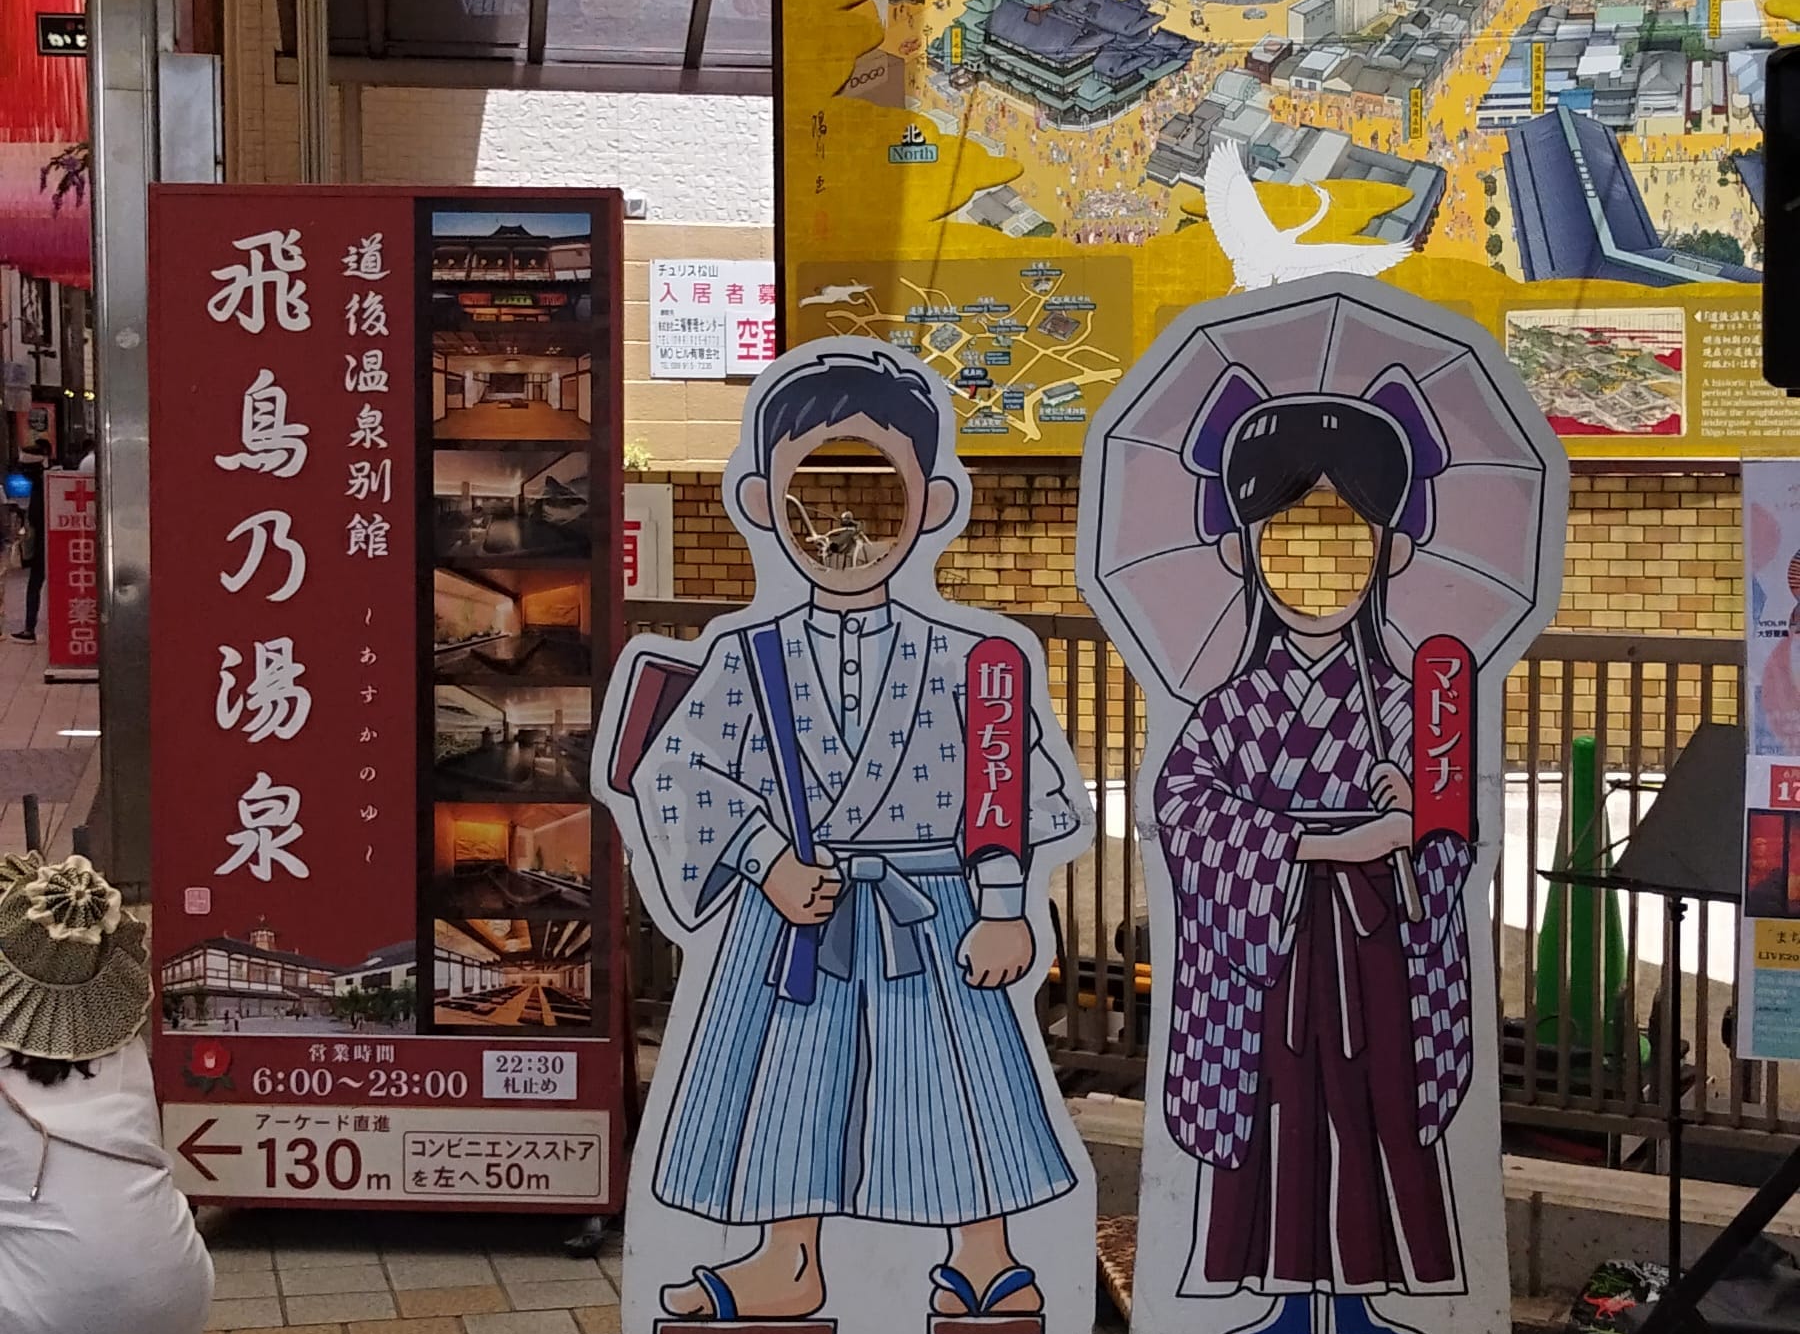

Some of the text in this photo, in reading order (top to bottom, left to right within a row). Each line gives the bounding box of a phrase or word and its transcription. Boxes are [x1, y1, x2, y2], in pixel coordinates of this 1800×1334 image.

[901, 123, 924, 144] 北
[892, 147, 935, 161] North
[341, 232, 392, 559] 道後温泉別館
[206, 227, 312, 882] 飛鳥乃湯泉
[67, 537, 98, 656] 田中薬品
[1424, 656, 1463, 794] マドンナ
[975, 661, 1016, 829] 坊っちゃん
[308, 1043, 396, 1065] 営業時間
[495, 1055, 565, 1075] 22:30
[503, 1078, 558, 1095] 札止め
[256, 1112, 392, 1134] アーケード直進
[410, 1138, 595, 1163] コンビニエンスストア
